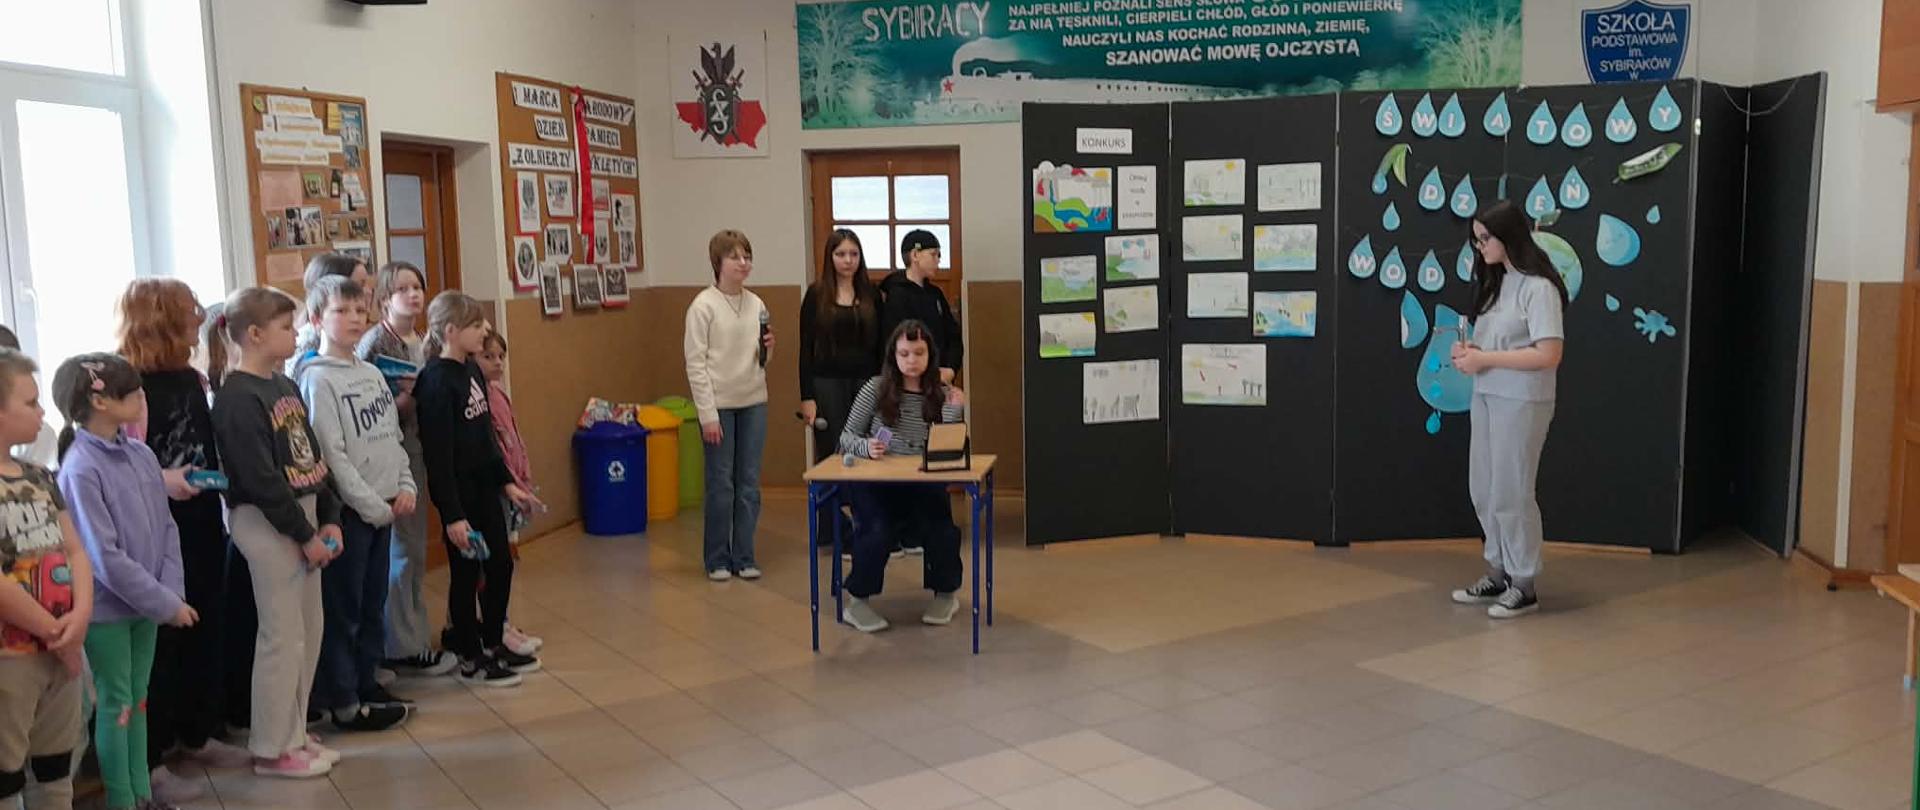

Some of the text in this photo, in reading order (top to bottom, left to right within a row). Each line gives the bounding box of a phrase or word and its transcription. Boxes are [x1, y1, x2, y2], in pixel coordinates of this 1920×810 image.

[1008, 0, 1404, 31] ZA NIĄ TĘSKNILI, CIERPIELI CHŁÓD, GŁÓD I PONIEWIERKĘ
[1009, 3, 1090, 16] NAJPEŁNIEJ
[862, 1, 990, 42] SYBIRACY
[1062, 18, 1371, 47] NAUCZYLI NAS KOCHAĆ RODZINNĄ, ZIEMIĘ,
[1597, 11, 1675, 33] SZKOŁA
[1592, 32, 1678, 48] PODSTAWOWA
[1105, 39, 1360, 66] SZANOWAĆ MOWĘ OJCZYSTĄ
[1600, 55, 1672, 73] SYBIRAKÓW
[524, 88, 559, 109] MARCA
[1081, 137, 1126, 148] KONKURS
[342, 380, 393, 438] Toronto
